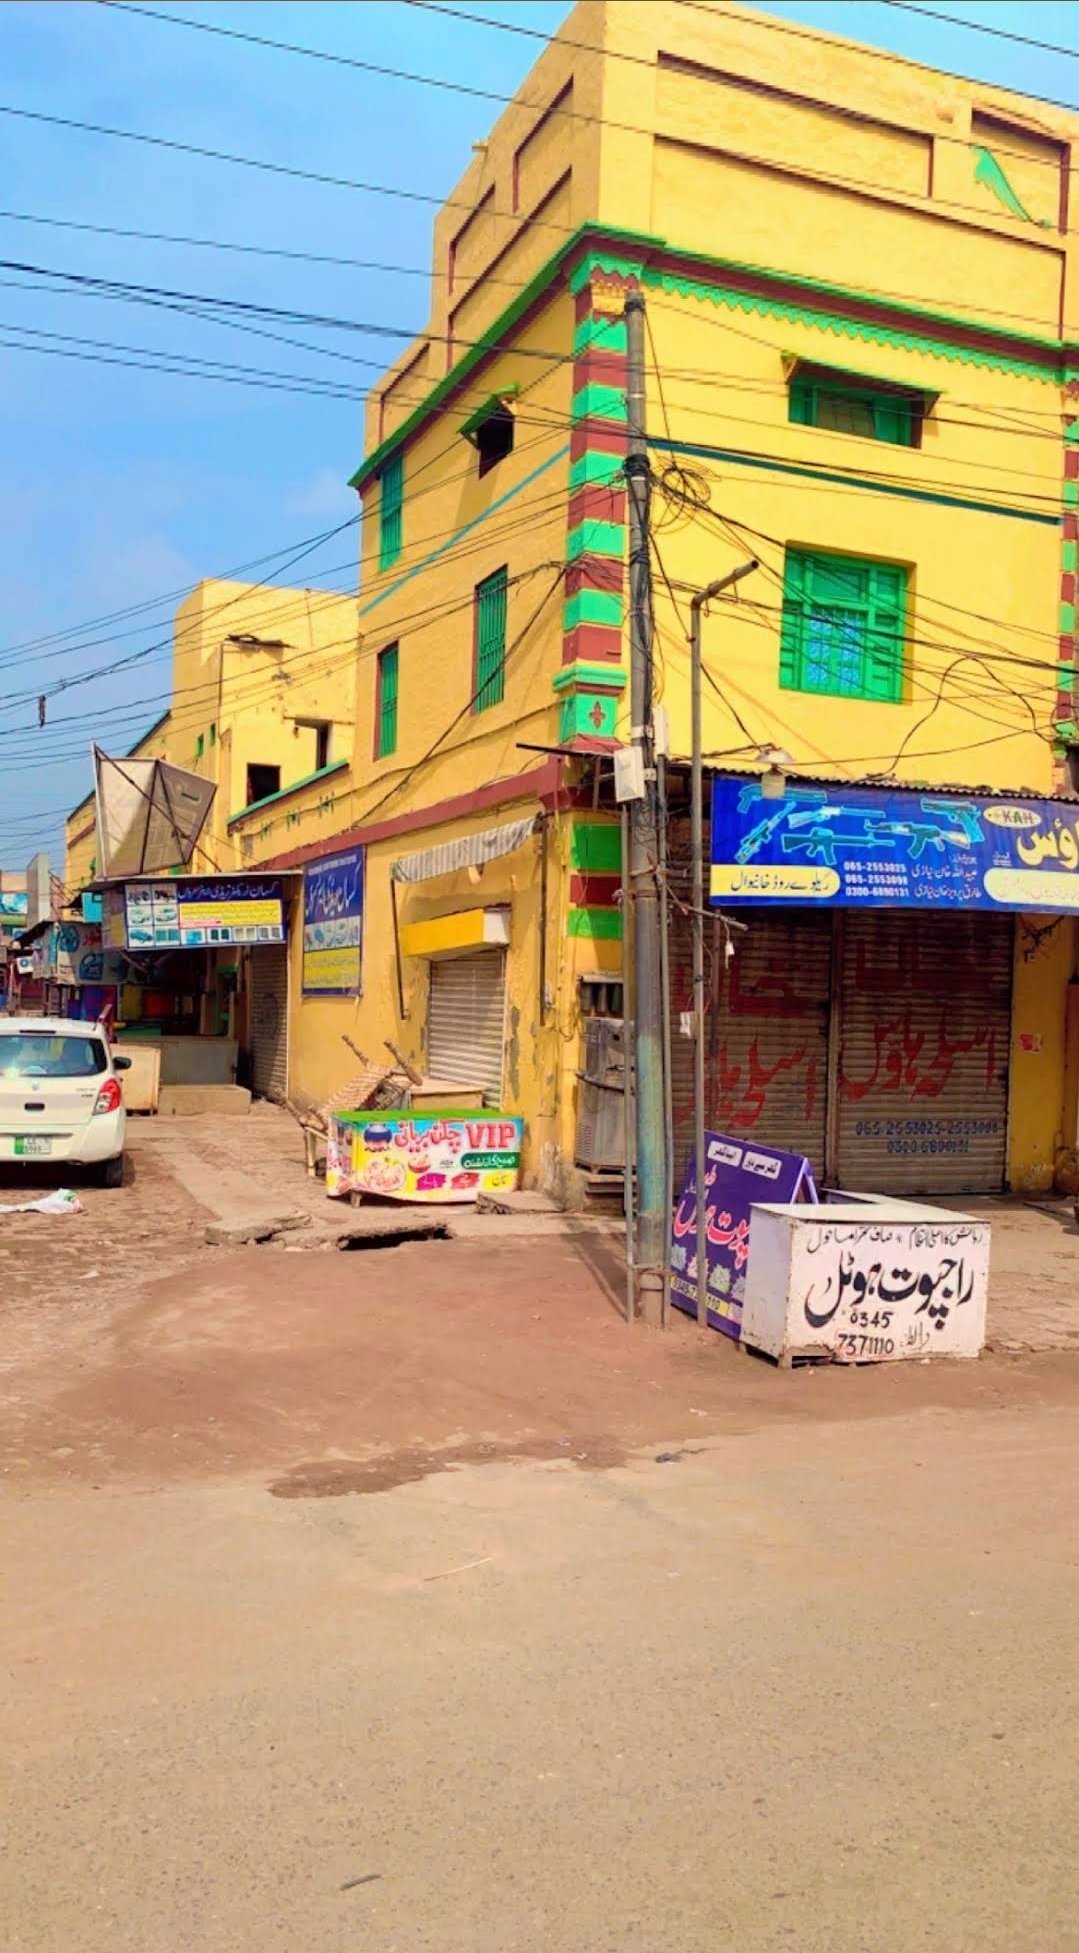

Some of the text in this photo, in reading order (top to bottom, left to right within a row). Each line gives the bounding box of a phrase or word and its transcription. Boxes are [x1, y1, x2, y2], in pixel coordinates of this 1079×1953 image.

[1002, 808, 1034, 824] KAH
[394, 1120, 431, 1153] بریانی
[465, 1122, 516, 1149] VIP
[804, 1250, 974, 1330] راجپوت ہوٹل
[850, 1311, 894, 1329] 0345
[838, 1333, 895, 1356] 7371110
